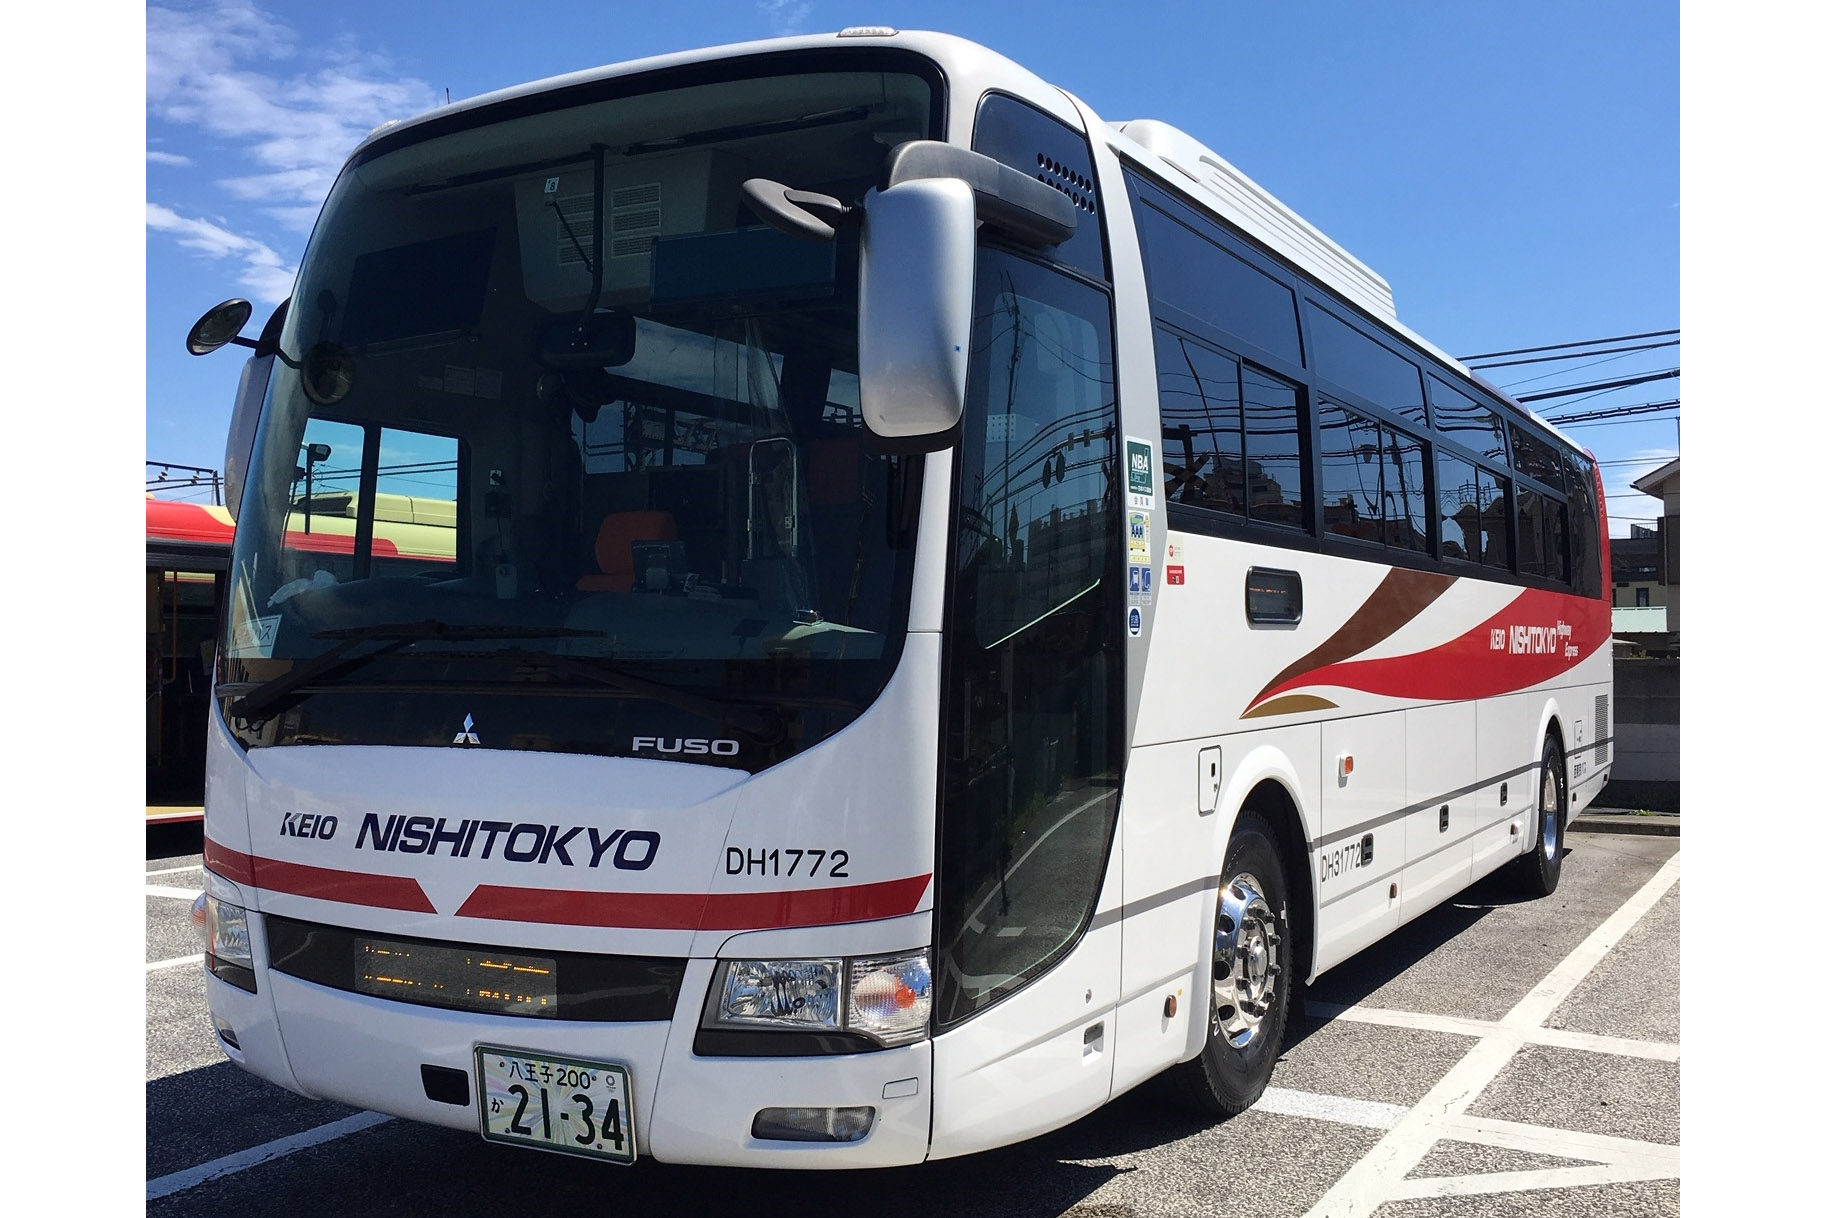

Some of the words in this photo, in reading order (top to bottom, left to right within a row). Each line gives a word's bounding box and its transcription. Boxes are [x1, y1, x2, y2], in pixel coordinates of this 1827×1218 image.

[1131, 453, 1149, 471] NBA
[1490, 628, 1506, 650] KEIO
[1508, 625, 1557, 655] NISHITOKYO
[632, 736, 740, 756] FUSO
[280, 812, 338, 840] KEIO
[355, 813, 661, 871] NISHITOKYO
[726, 847, 849, 878] DH1772
[1321, 842, 1361, 882] DH31772
[491, 1097, 505, 1114] か
[508, 1084, 625, 1151] 21-34
